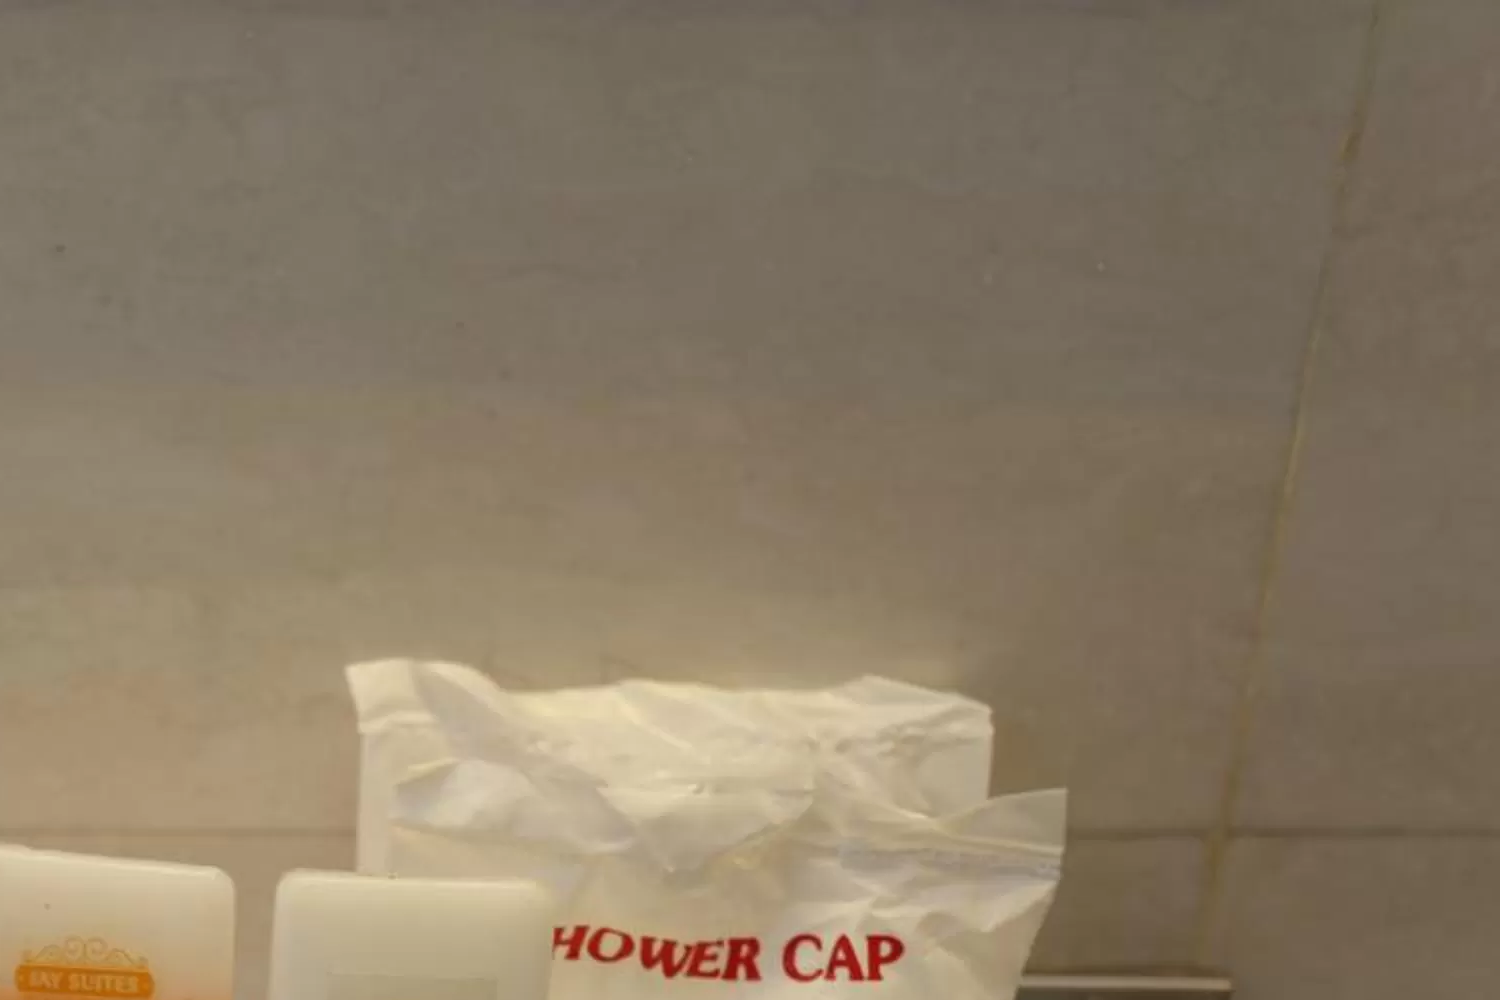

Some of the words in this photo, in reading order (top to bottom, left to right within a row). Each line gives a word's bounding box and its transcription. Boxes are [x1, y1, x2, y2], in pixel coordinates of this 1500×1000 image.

[551, 925, 762, 982] HOWER
[782, 932, 905, 983] CAP
[28, 969, 63, 989] JAY
[68, 973, 140, 994] SUITES
